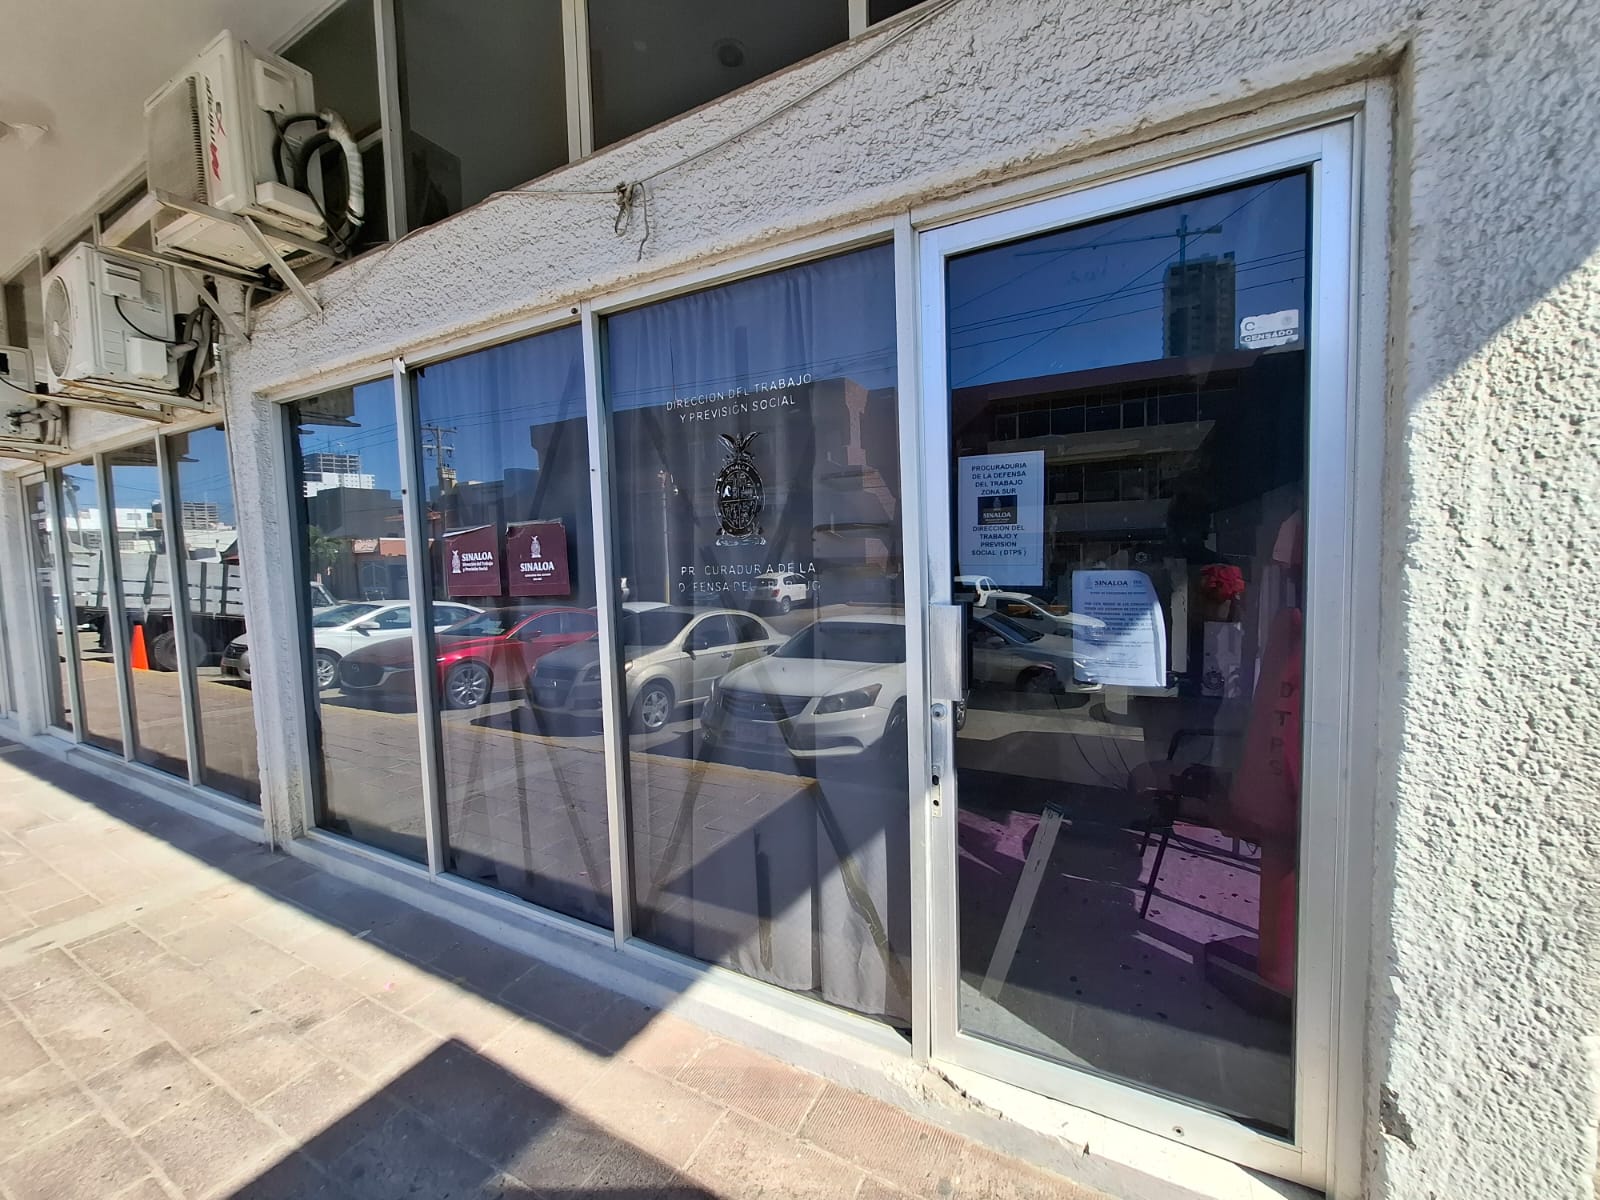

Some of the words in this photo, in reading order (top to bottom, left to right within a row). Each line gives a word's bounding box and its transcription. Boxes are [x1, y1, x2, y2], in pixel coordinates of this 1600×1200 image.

[1244, 329, 1293, 342] CENSADO
[728, 386, 749, 399] DEL
[754, 373, 812, 393] TRABAJO
[680, 414, 687, 424] Y
[689, 401, 748, 422] PREVISIÓN
[752, 394, 796, 412] SOCIAL
[972, 462, 1027, 472] PROCURADURIA
[993, 471, 1027, 479] DEFENSA
[991, 479, 1023, 487] TRABAJO
[983, 511, 1012, 519] SINALOA
[461, 551, 493, 562] SINALOA
[520, 561, 555, 572] SINALOA
[778, 562, 794, 574] DE
[800, 562, 816, 574] LA
[679, 581, 730, 592] DFENSA
